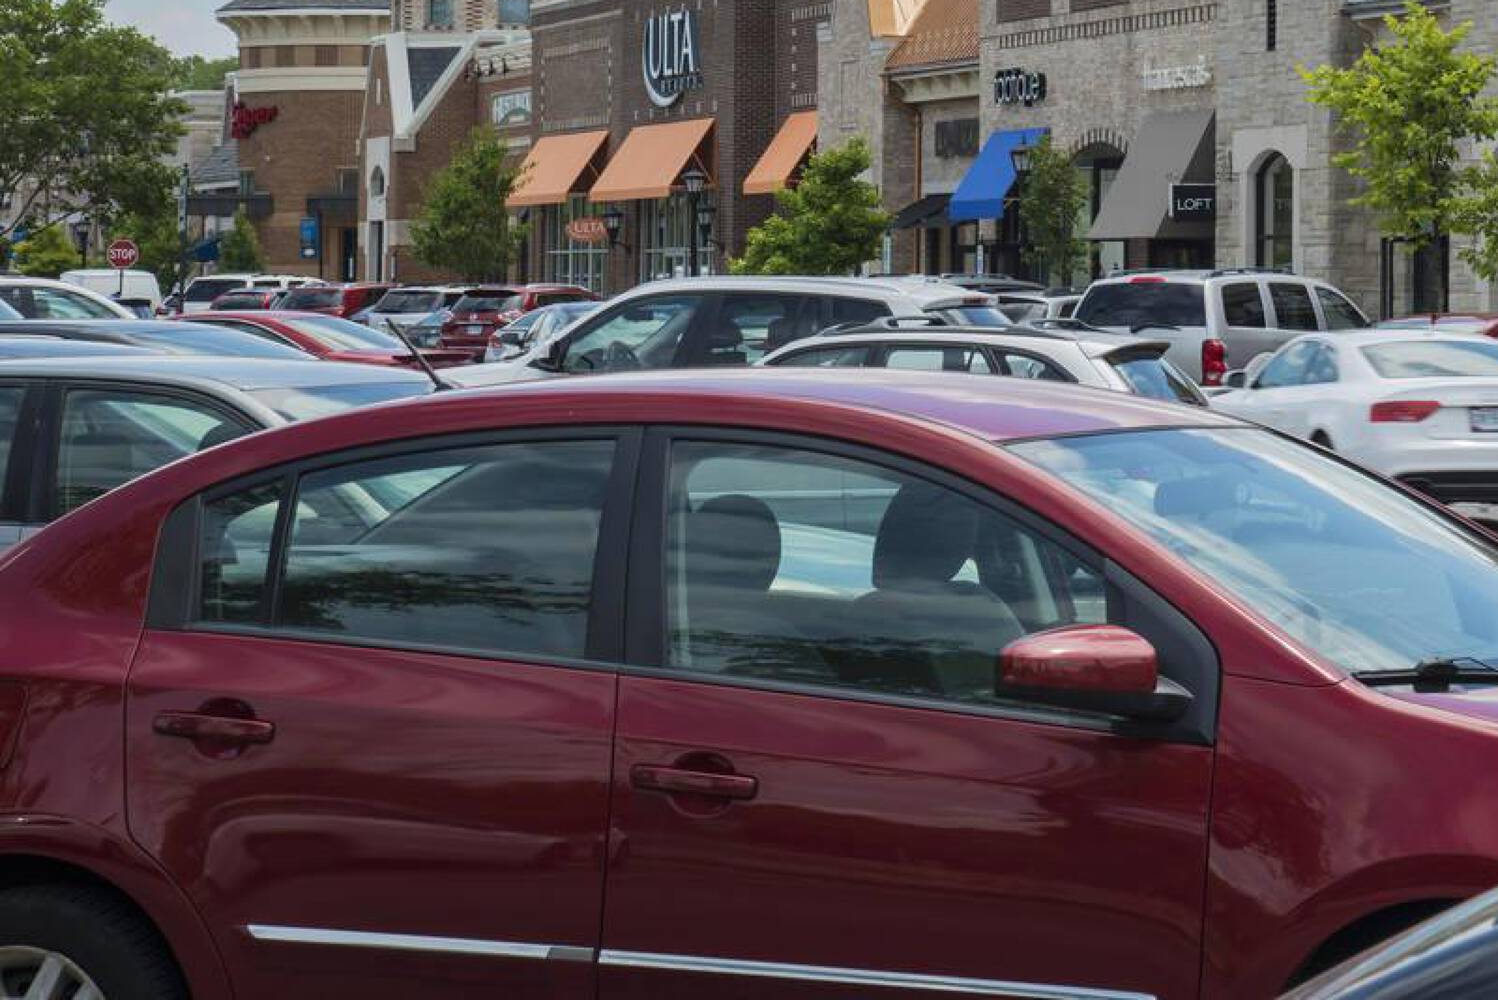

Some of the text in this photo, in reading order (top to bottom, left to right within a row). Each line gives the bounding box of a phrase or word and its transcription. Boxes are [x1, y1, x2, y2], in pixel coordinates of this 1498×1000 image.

[648, 8, 694, 80] ULTA
[1177, 197, 1213, 211] LOFT
[110, 248, 136, 260] STOP
